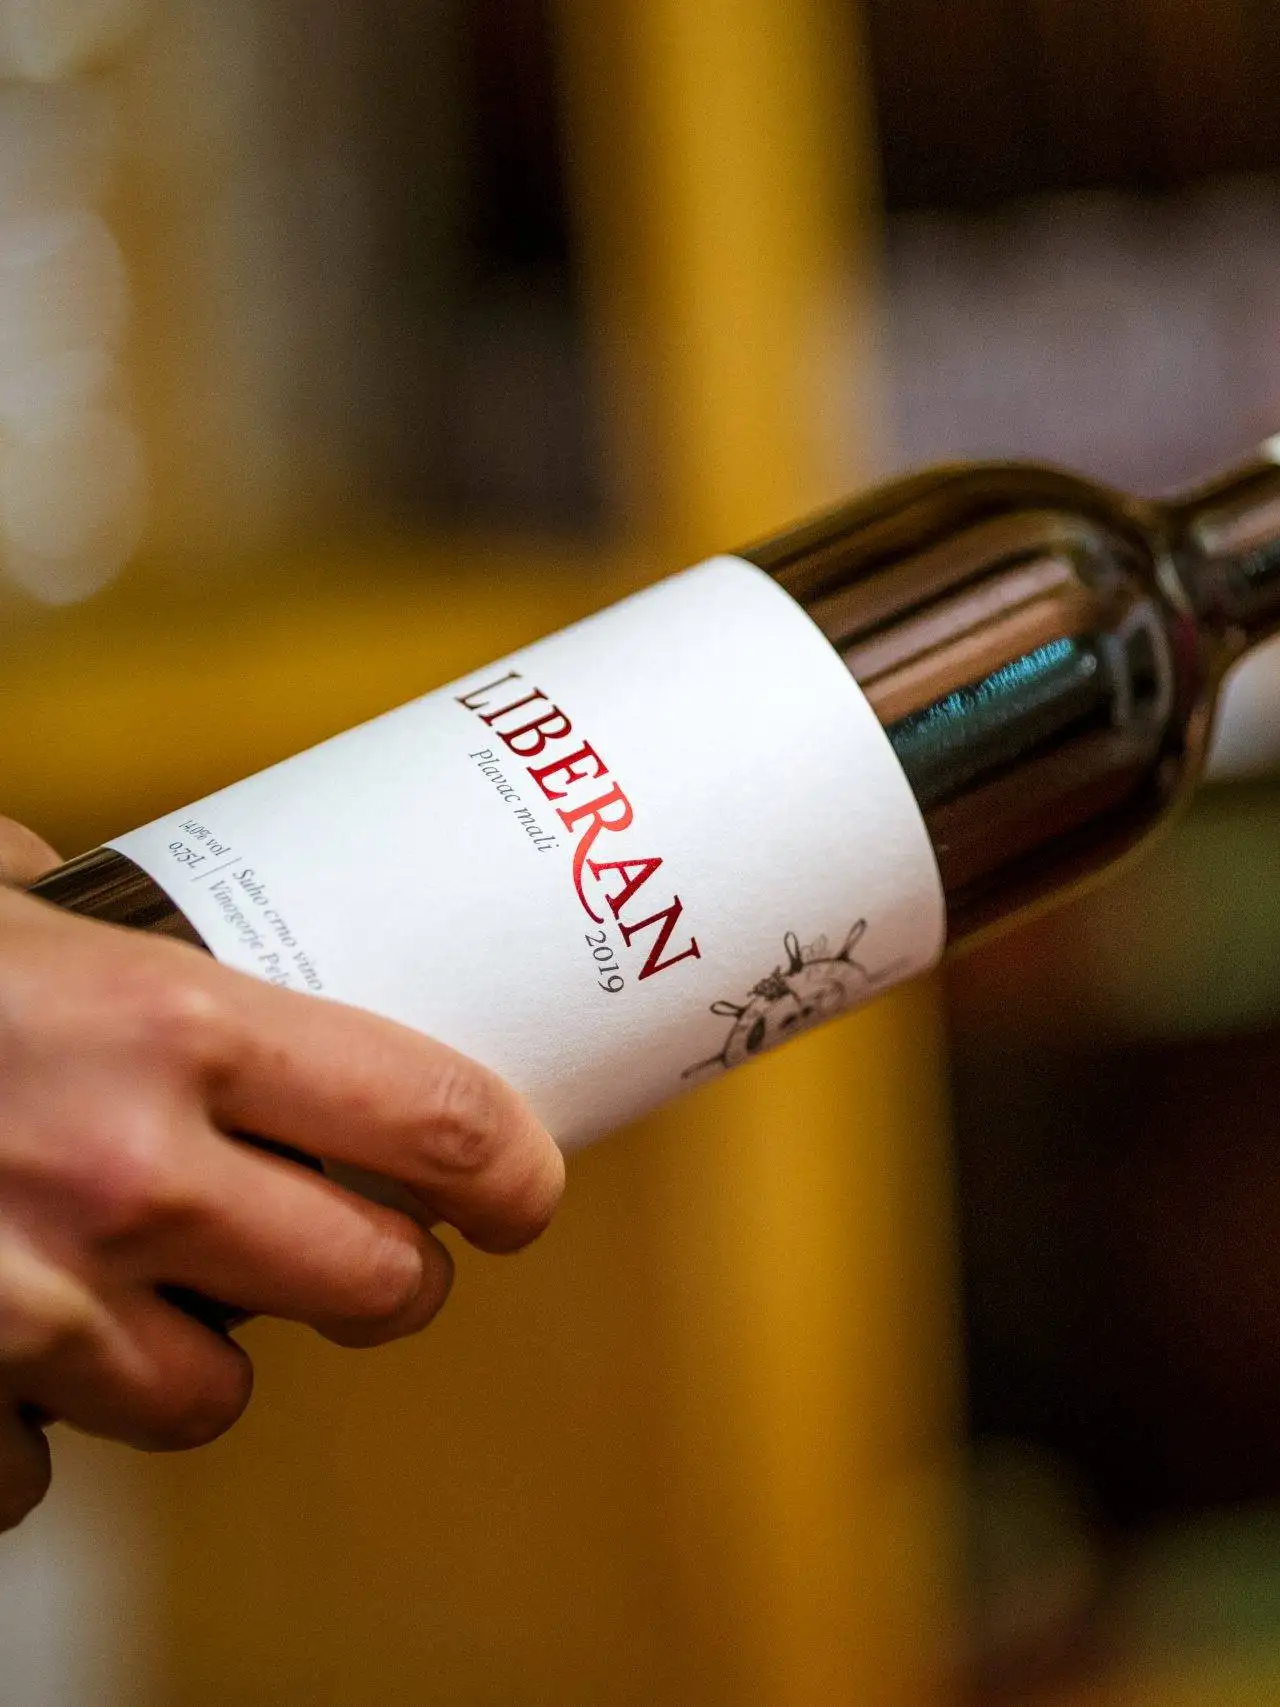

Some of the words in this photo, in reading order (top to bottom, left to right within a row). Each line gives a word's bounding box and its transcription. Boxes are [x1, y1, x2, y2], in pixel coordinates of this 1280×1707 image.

[454, 670, 701, 981] LIBERAN
[469, 748, 521, 804] Plavac
[514, 807, 560, 854] mali
[206, 838, 232, 857] vol
[209, 880, 264, 950] Vinogorje
[232, 868, 268, 906] Suho
[263, 909, 297, 948] crno
[292, 950, 323, 992] vino
[584, 930, 625, 994] 2019
